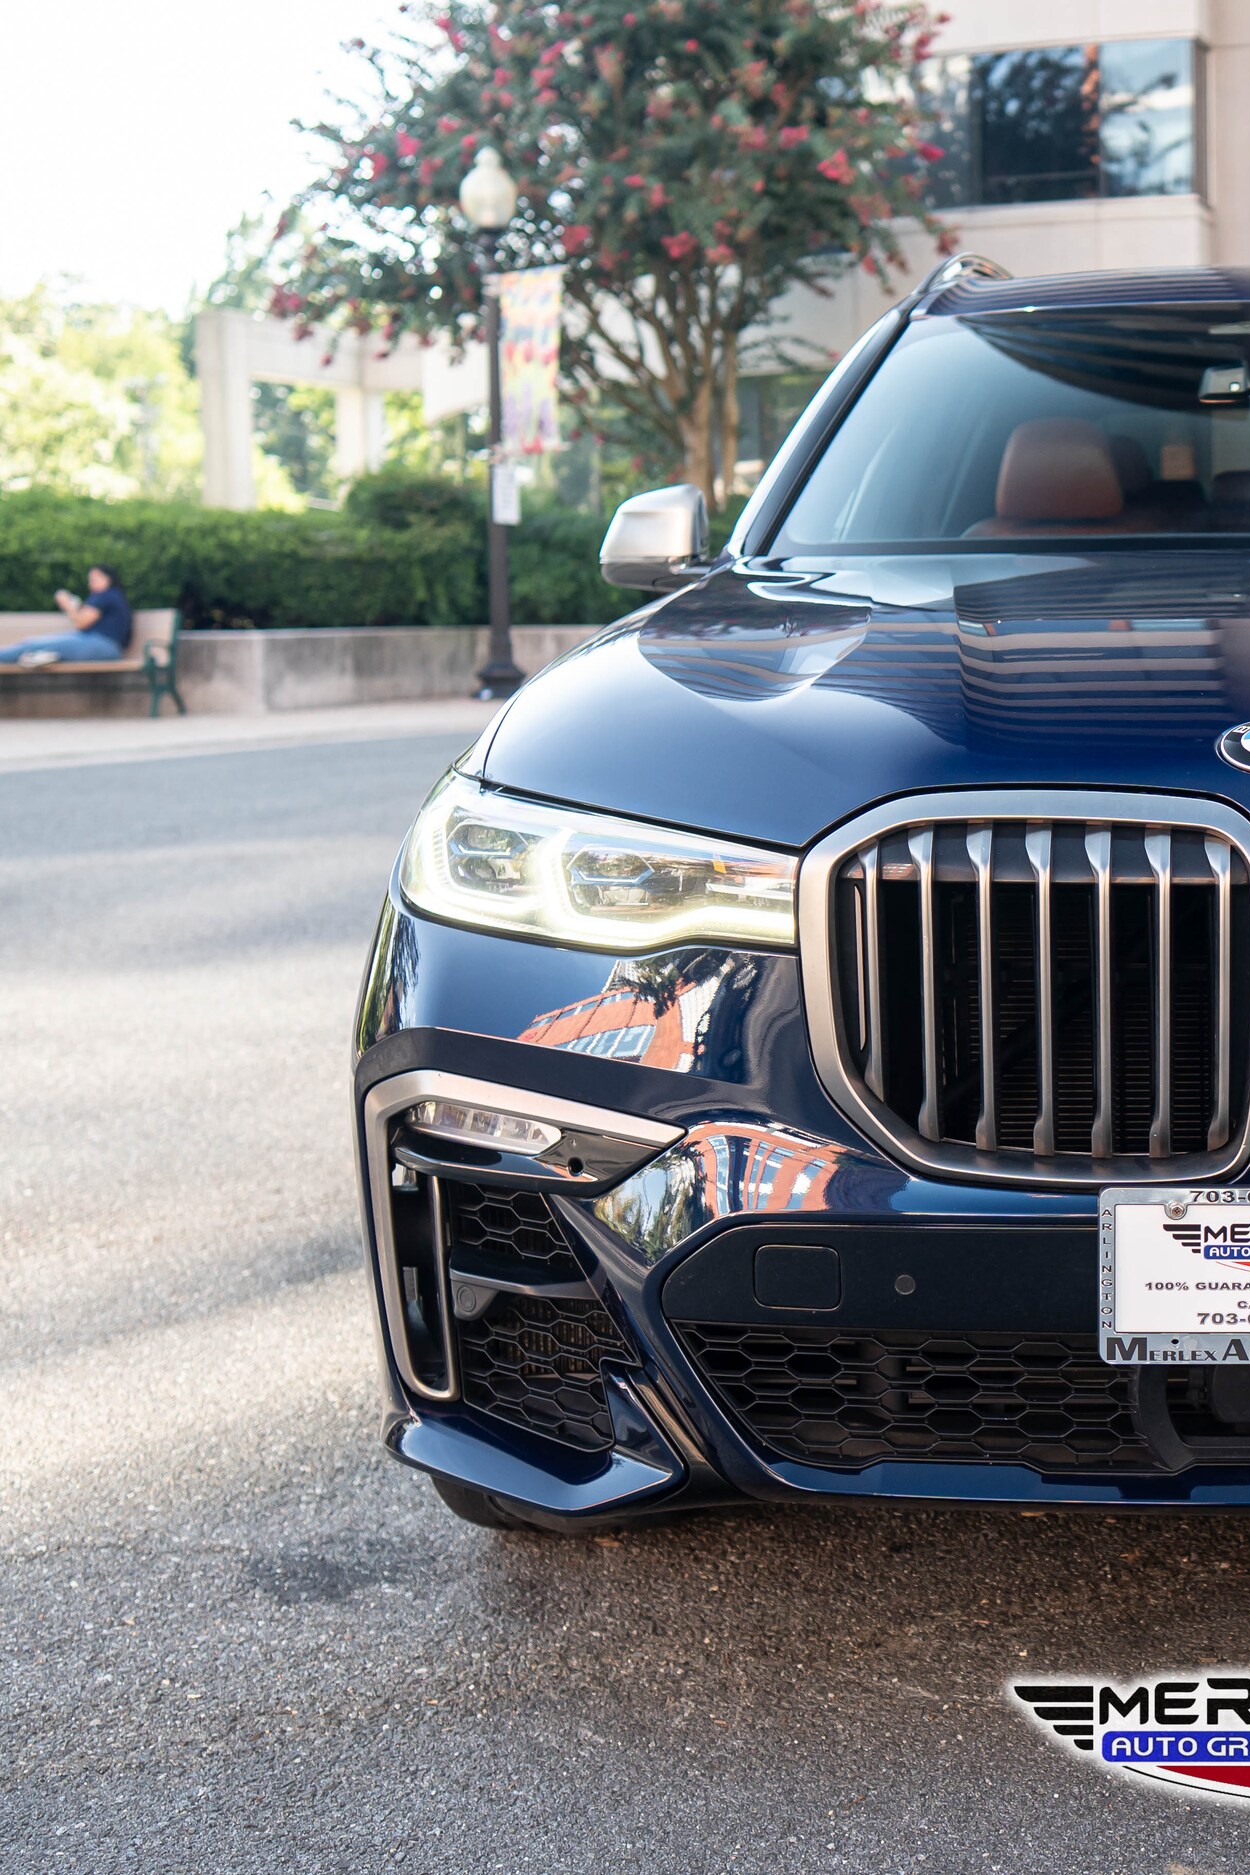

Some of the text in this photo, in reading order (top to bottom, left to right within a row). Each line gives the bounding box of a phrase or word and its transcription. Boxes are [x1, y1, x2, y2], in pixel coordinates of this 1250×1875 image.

[1209, 1247, 1250, 1257] AUTO
[1101, 1208, 1113, 1329] ARLINGTON
[1145, 1282, 1189, 1291] 100%
